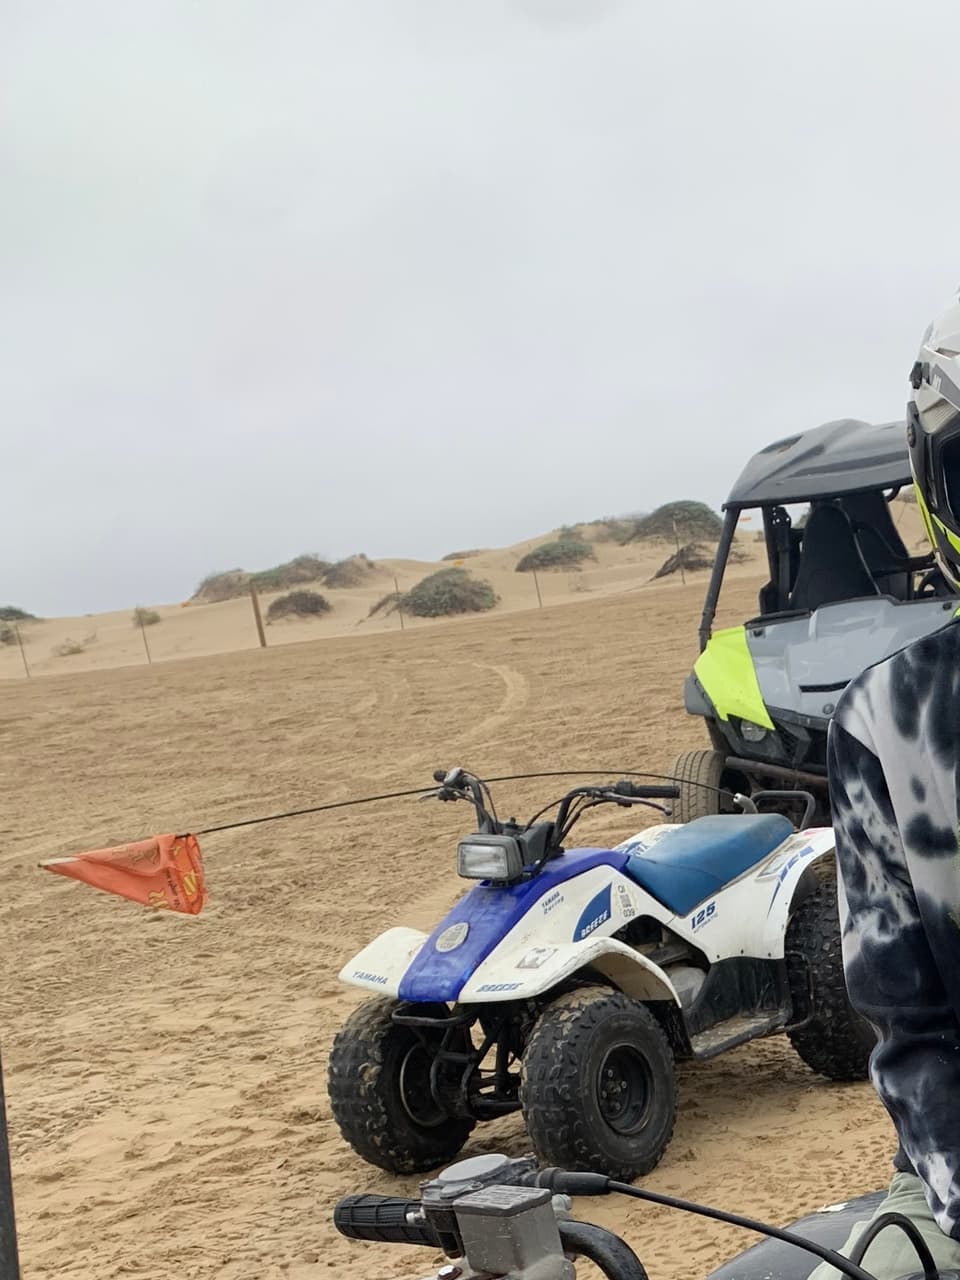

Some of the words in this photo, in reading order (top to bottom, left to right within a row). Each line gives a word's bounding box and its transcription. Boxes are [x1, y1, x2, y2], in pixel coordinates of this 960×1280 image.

[581, 911, 608, 937] BREEZE
[691, 901, 716, 930] 125
[352, 971, 389, 985] YAMAHA
